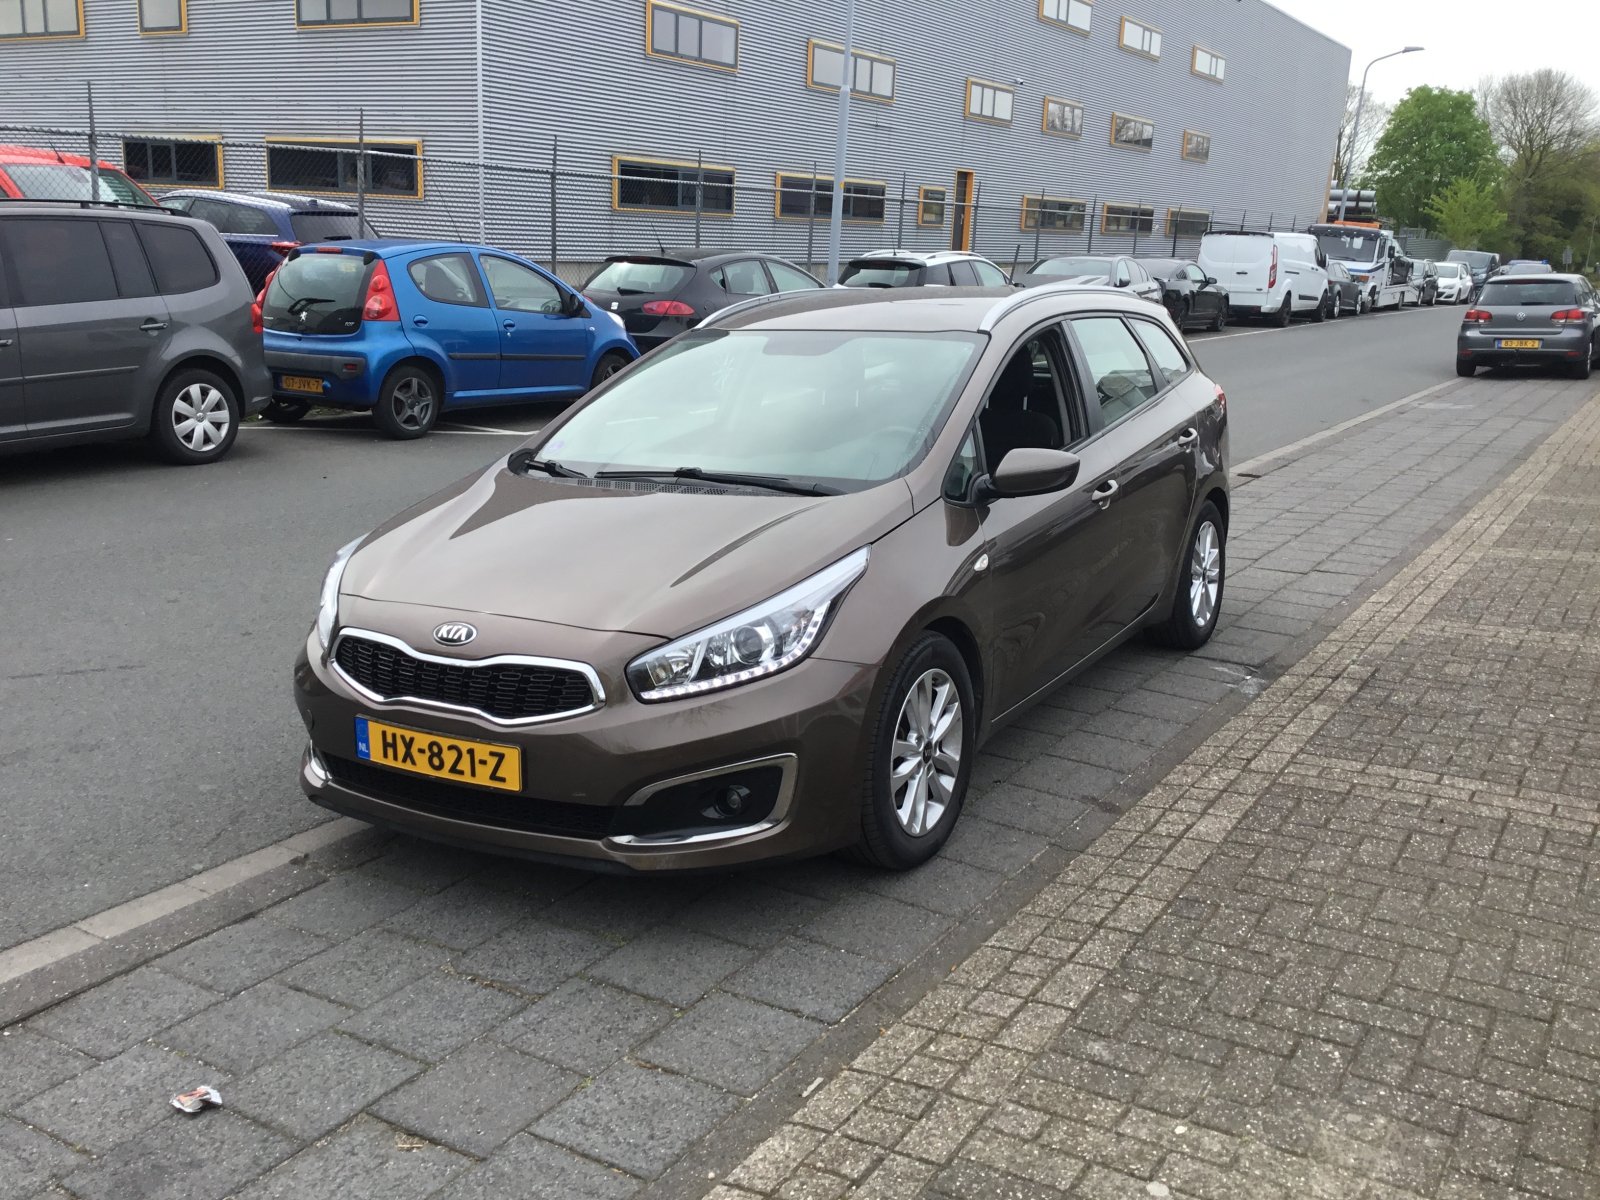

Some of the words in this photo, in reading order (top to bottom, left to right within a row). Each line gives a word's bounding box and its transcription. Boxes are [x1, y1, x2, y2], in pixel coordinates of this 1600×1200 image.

[437, 624, 468, 641] KIA
[358, 741, 369, 753] NL
[381, 730, 507, 783] HX-821-Z
